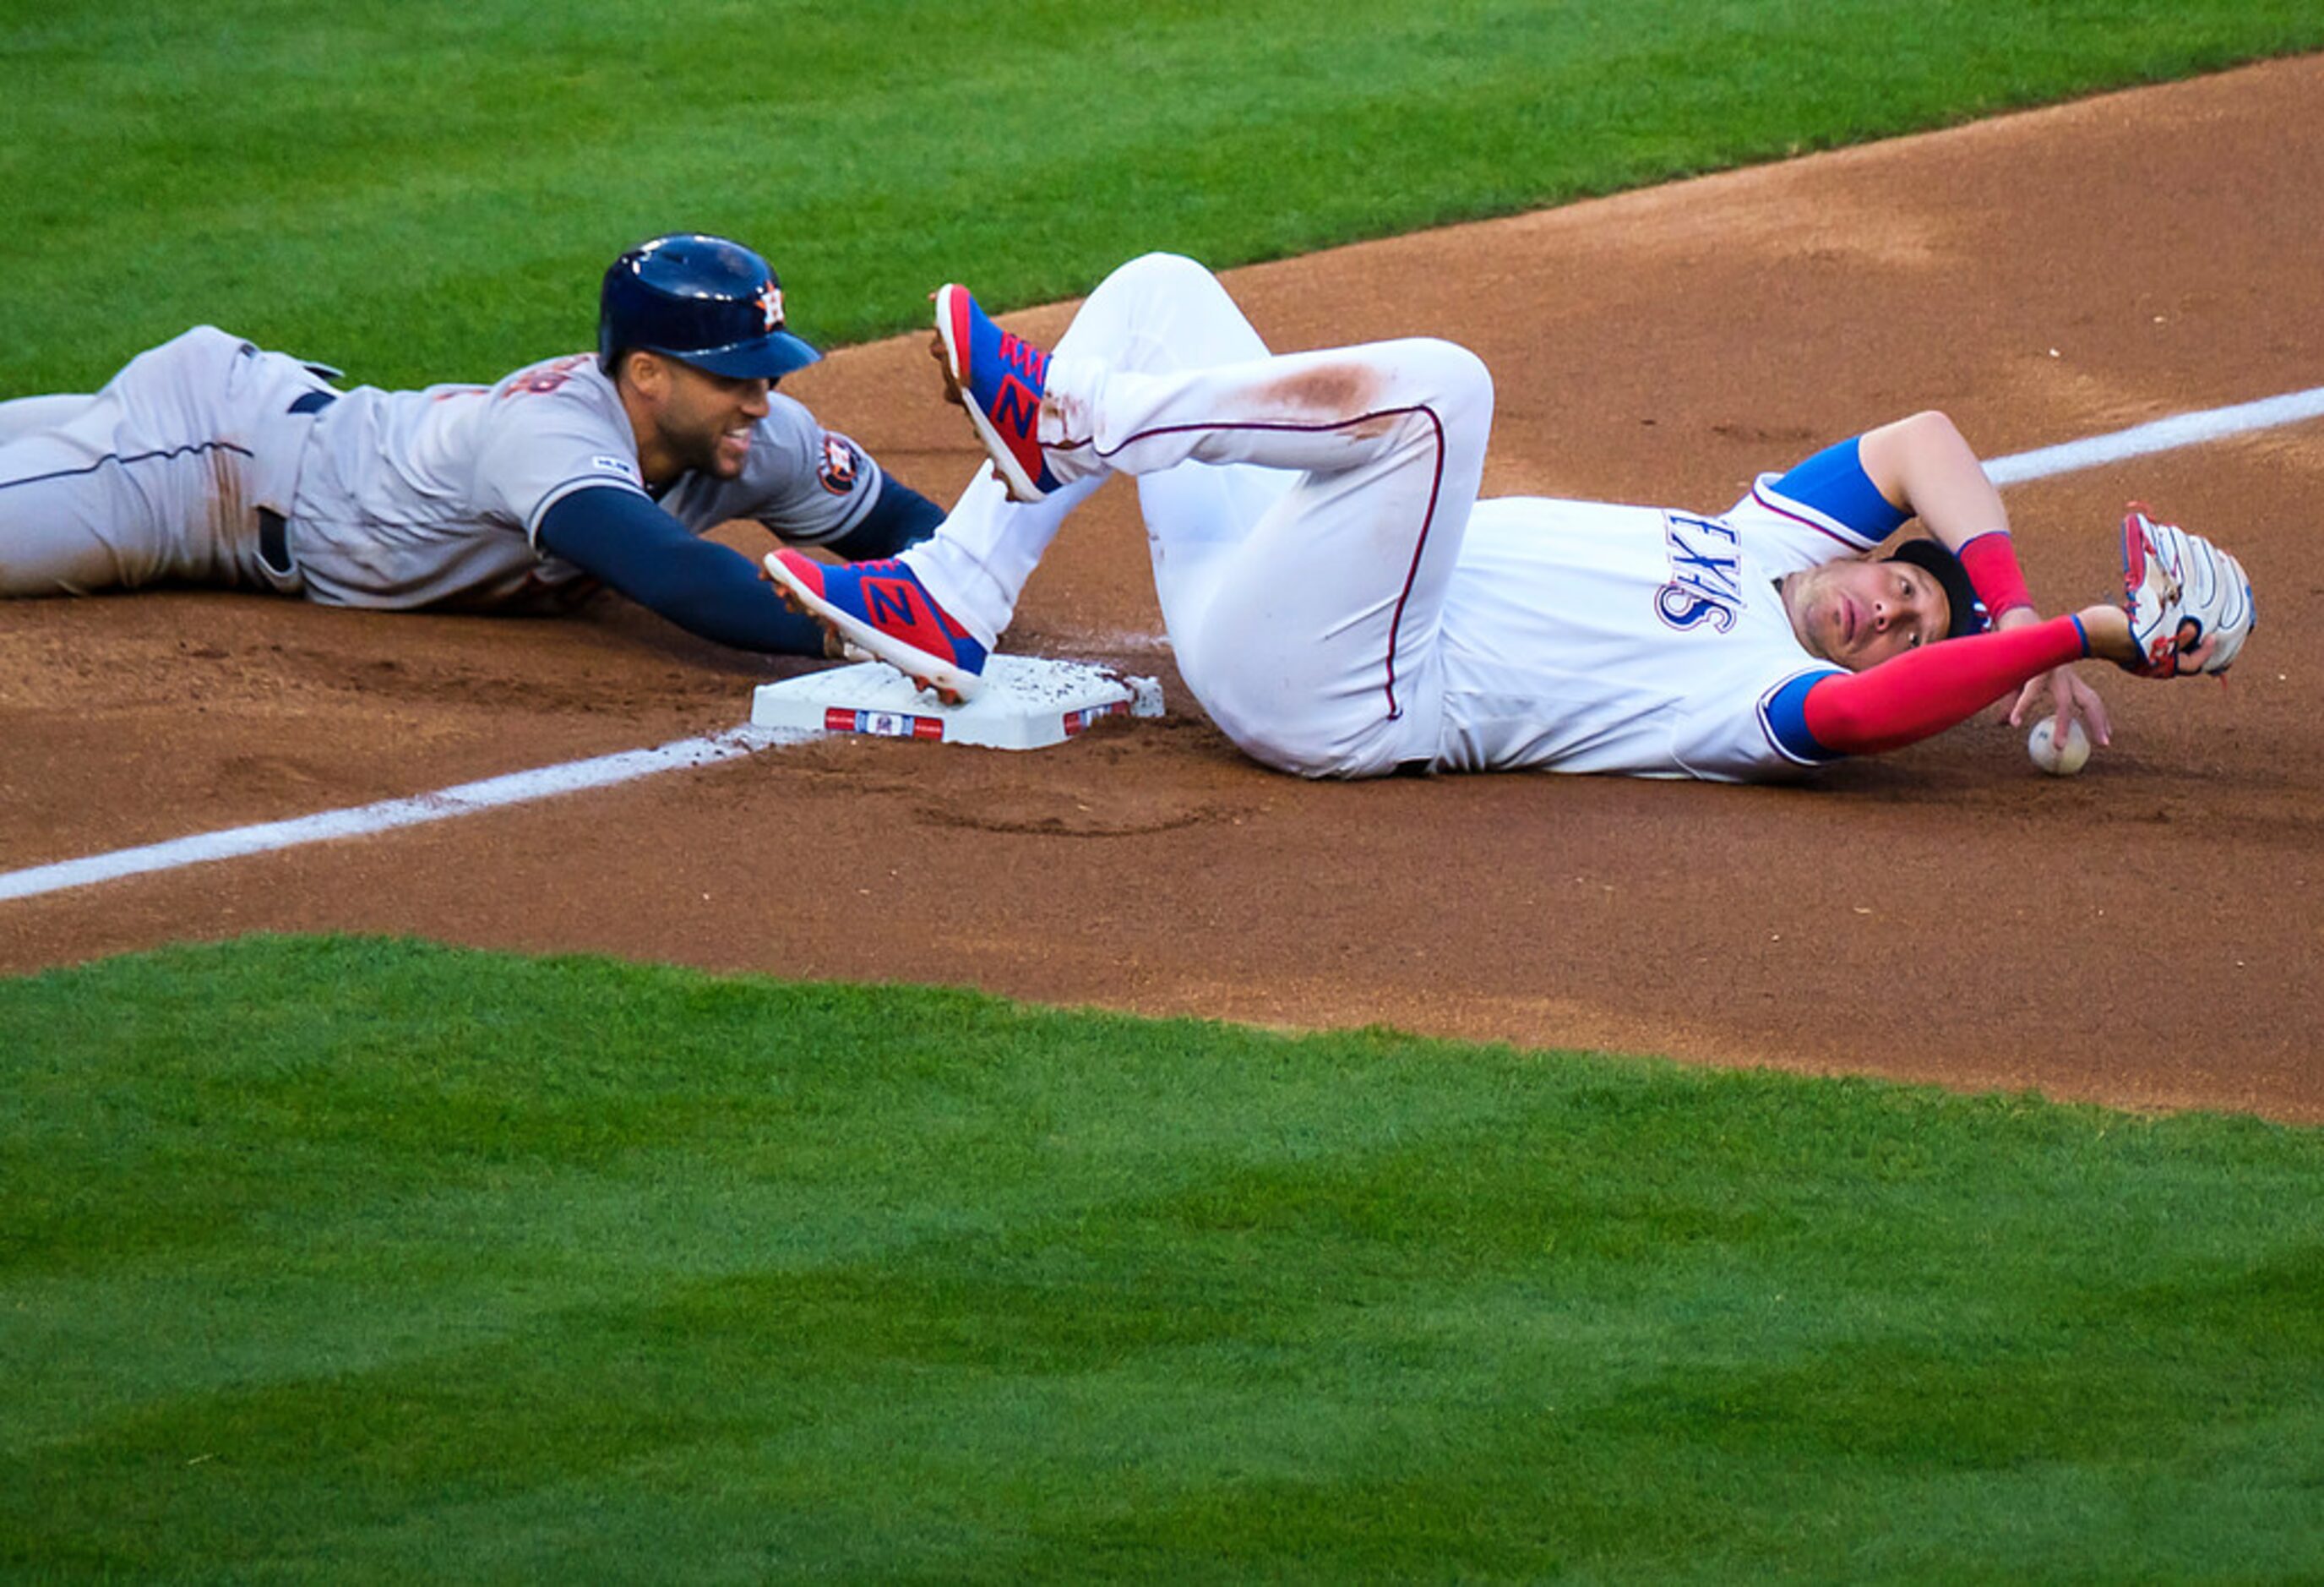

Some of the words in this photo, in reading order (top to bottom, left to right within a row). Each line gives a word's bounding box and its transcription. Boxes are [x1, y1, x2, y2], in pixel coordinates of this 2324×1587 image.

[995, 382, 1037, 440] N
[1656, 511, 1745, 634] EXAS
[868, 582, 917, 626] N
